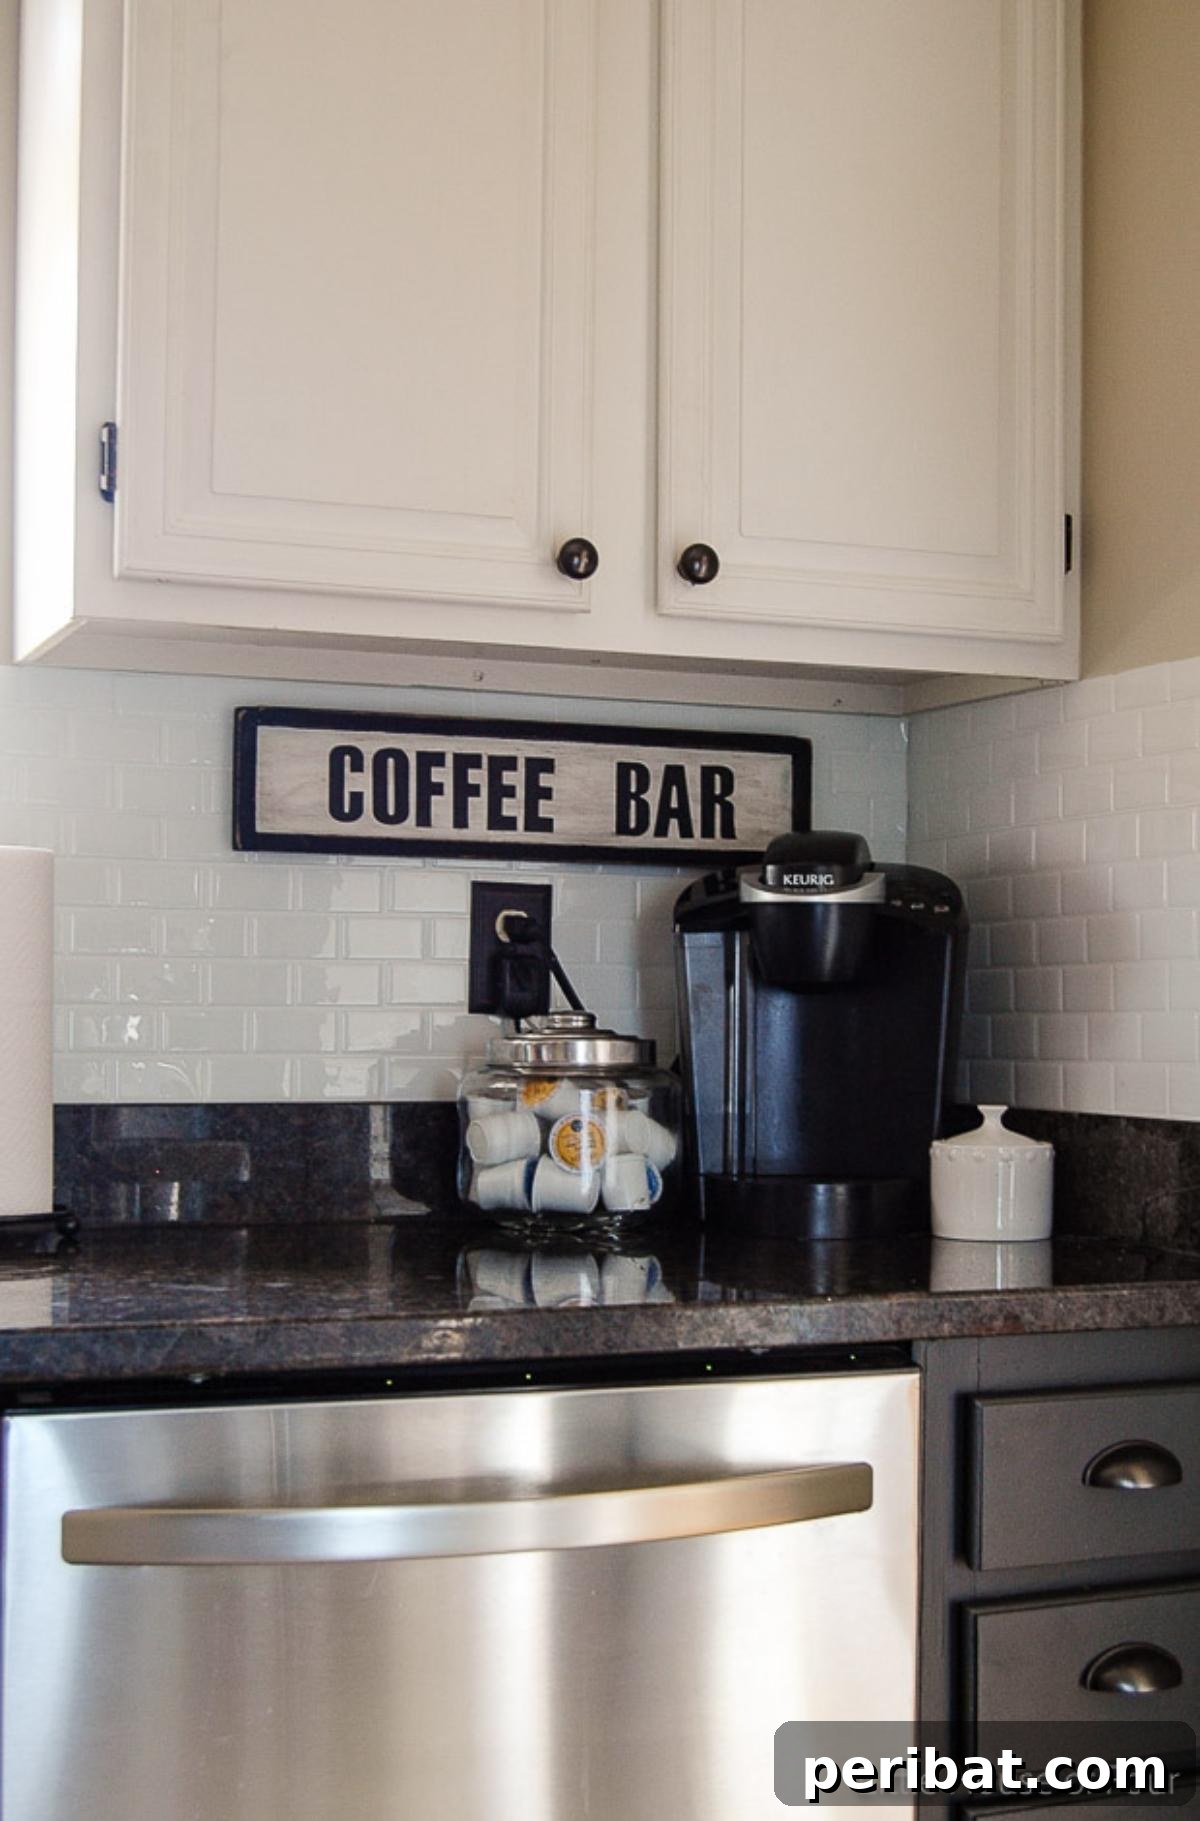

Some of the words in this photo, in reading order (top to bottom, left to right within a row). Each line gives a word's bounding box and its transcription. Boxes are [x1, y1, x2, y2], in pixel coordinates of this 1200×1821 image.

[328, 744, 556, 834] COFFEE
[614, 761, 738, 841] BAR
[783, 874, 834, 886] KEURIG
